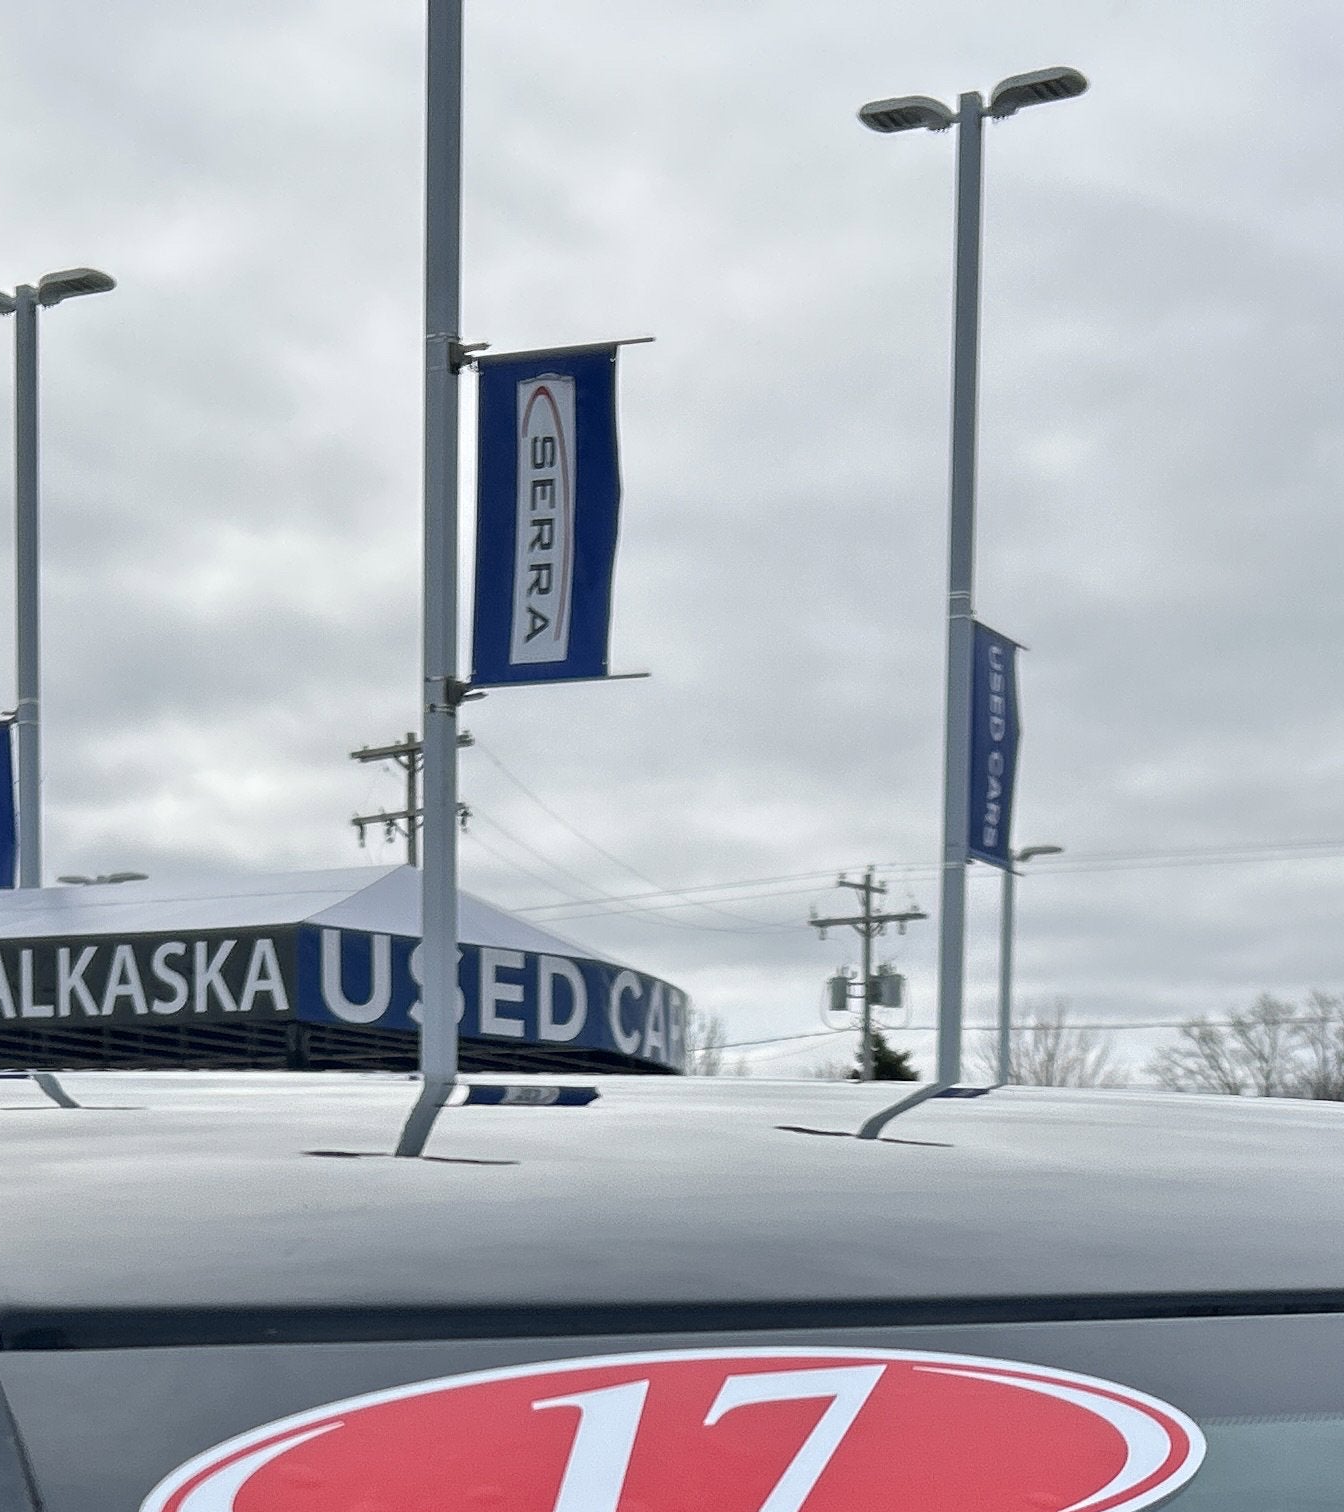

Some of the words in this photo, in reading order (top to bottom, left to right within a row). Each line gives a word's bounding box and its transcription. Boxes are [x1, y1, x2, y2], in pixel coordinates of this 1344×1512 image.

[524, 436, 556, 644] SERRA
[988, 645, 1005, 741] USED
[983, 751, 1004, 848] CARS
